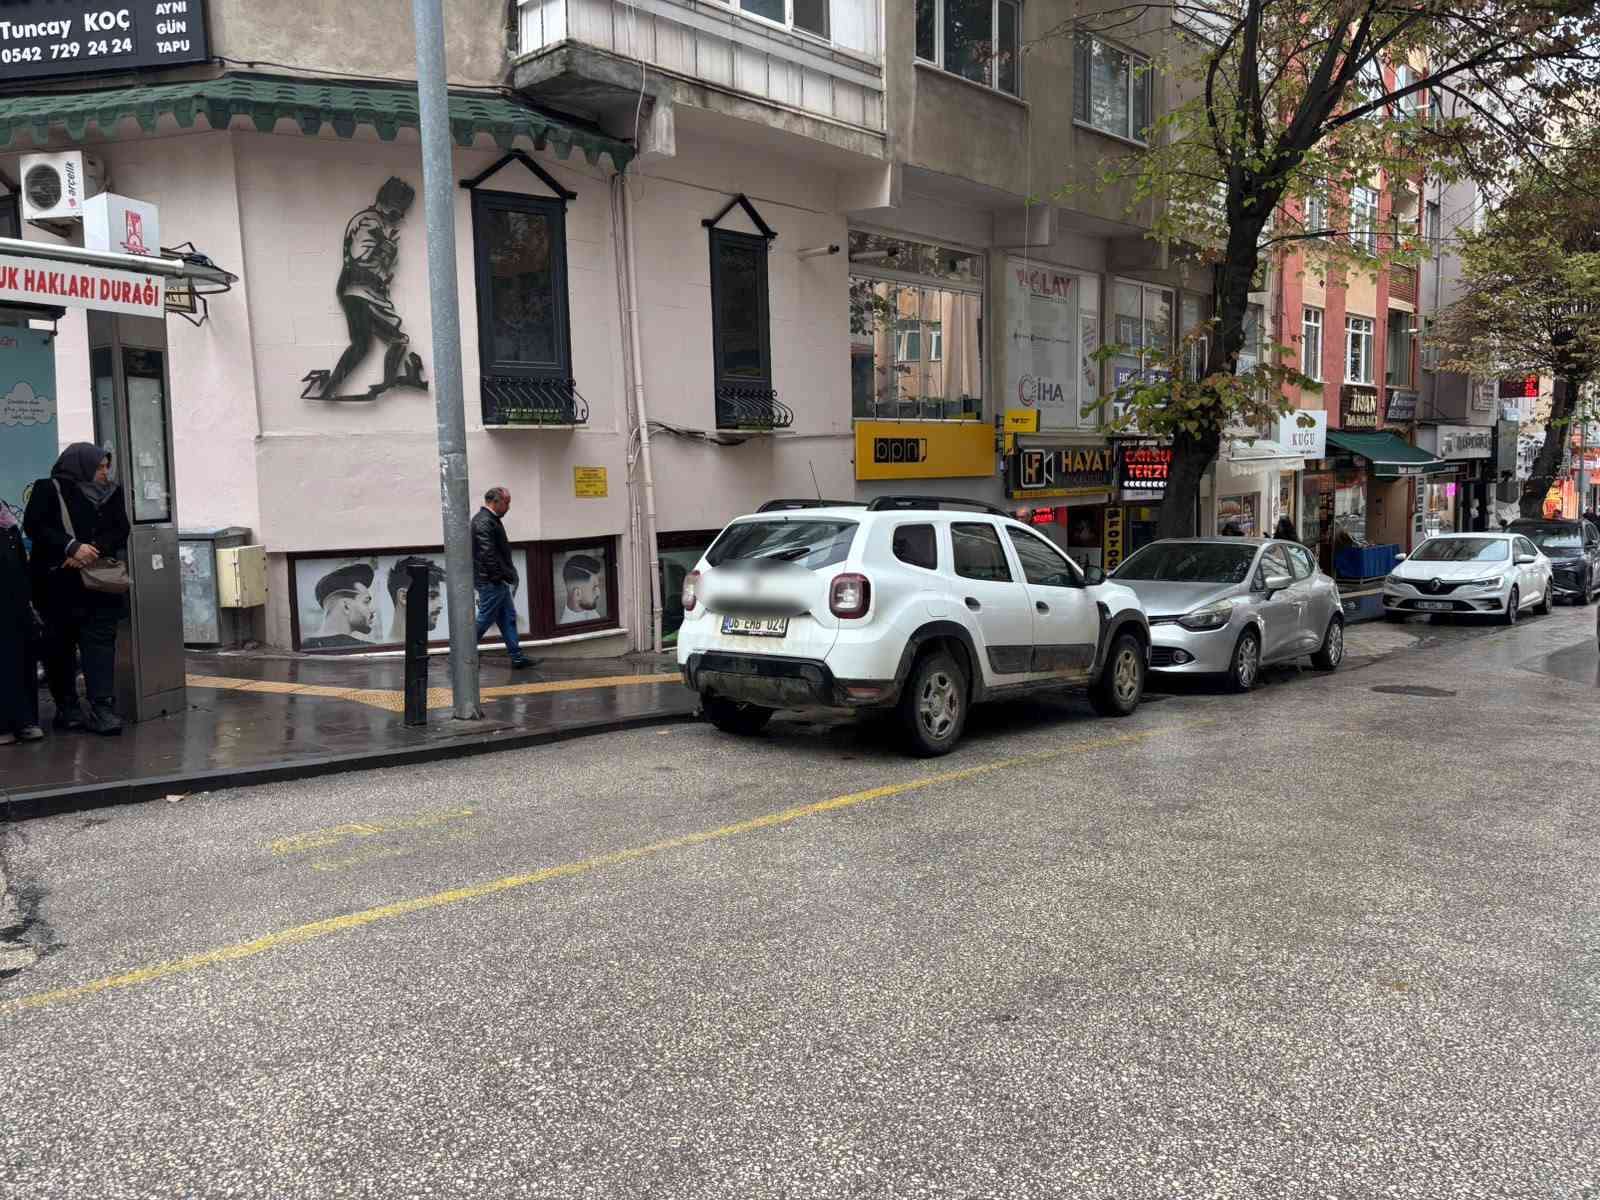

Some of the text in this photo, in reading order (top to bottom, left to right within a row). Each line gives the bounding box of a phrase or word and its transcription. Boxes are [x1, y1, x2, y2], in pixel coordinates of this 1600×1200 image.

[155, 1, 187, 15] AYNI
[0, 9, 130, 40] Tuncay KOÇ
[156, 20, 187, 35] GÜN
[1, 38, 133, 63] 0542 729 24 24
[156, 40, 190, 53] TAPU
[24, 269, 96, 299] HAKLARI
[100, 275, 159, 307] DURAĞI
[1061, 449, 1113, 473] HAYAT
